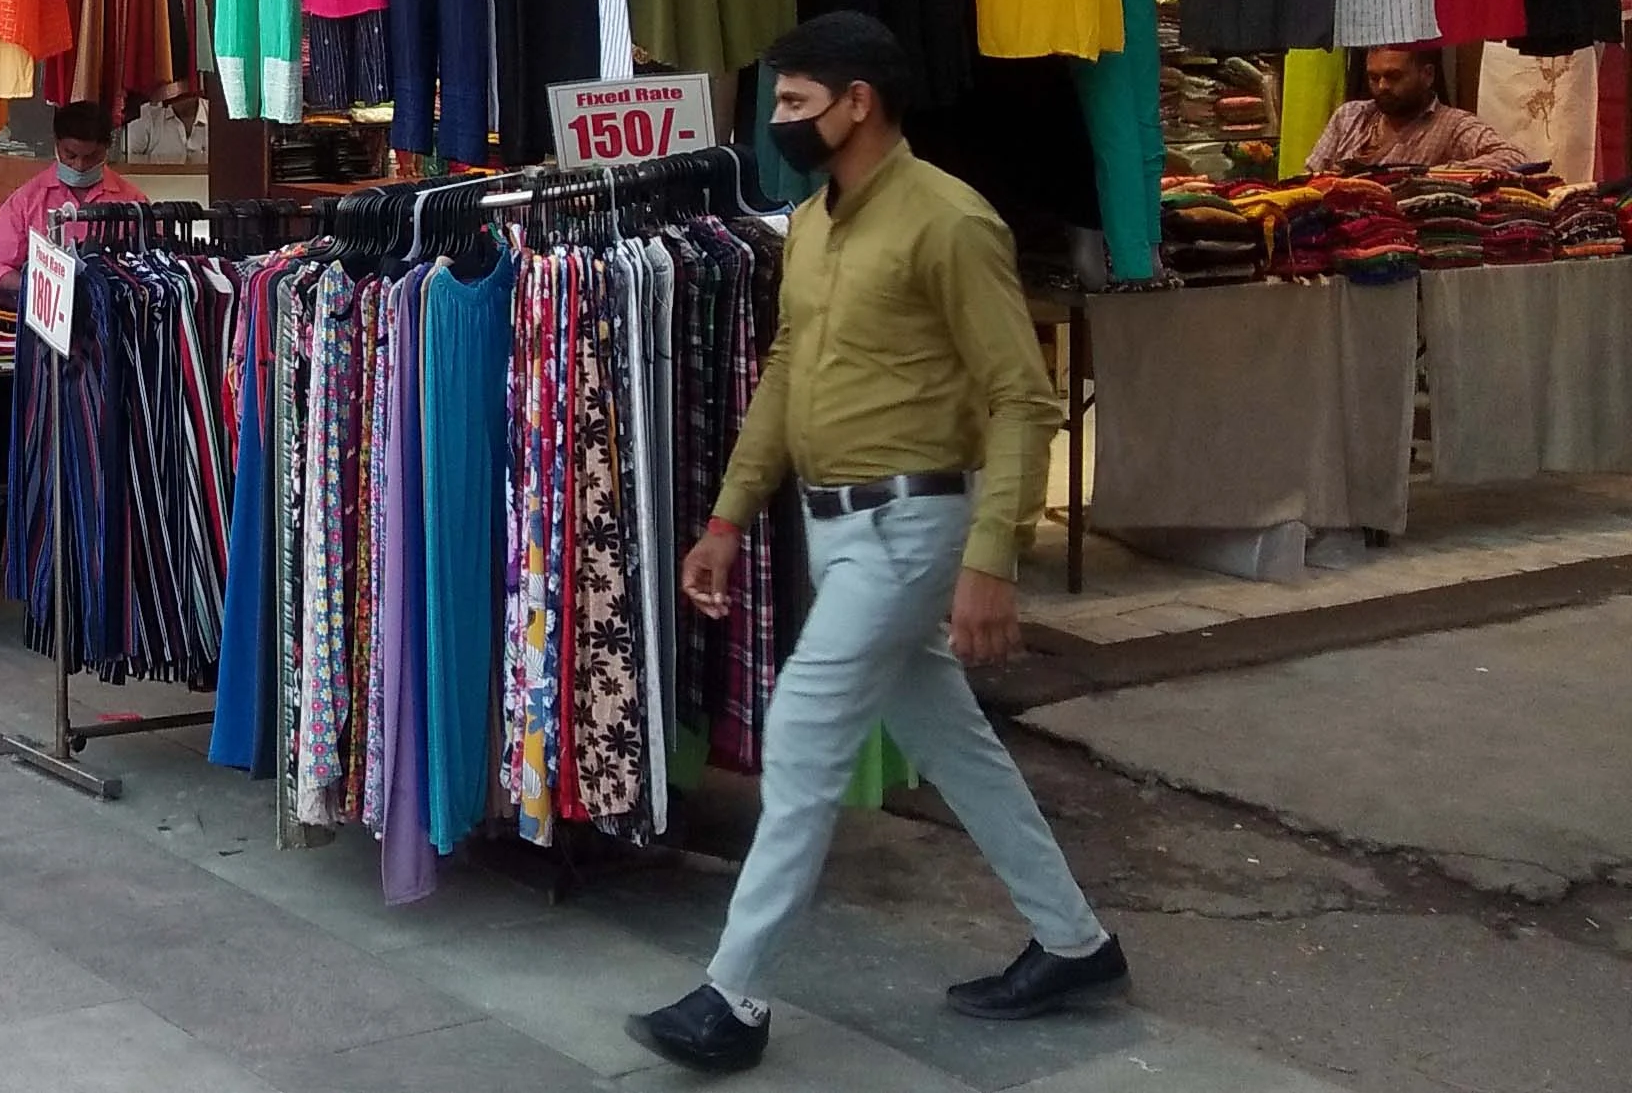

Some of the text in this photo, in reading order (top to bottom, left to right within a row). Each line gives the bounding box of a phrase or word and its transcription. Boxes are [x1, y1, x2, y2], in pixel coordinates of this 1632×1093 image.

[576, 88, 683, 106] Fixed Rate
[568, 107, 695, 160] 150/-
[50, 256, 65, 277] Rate
[32, 268, 65, 333] 180/-
